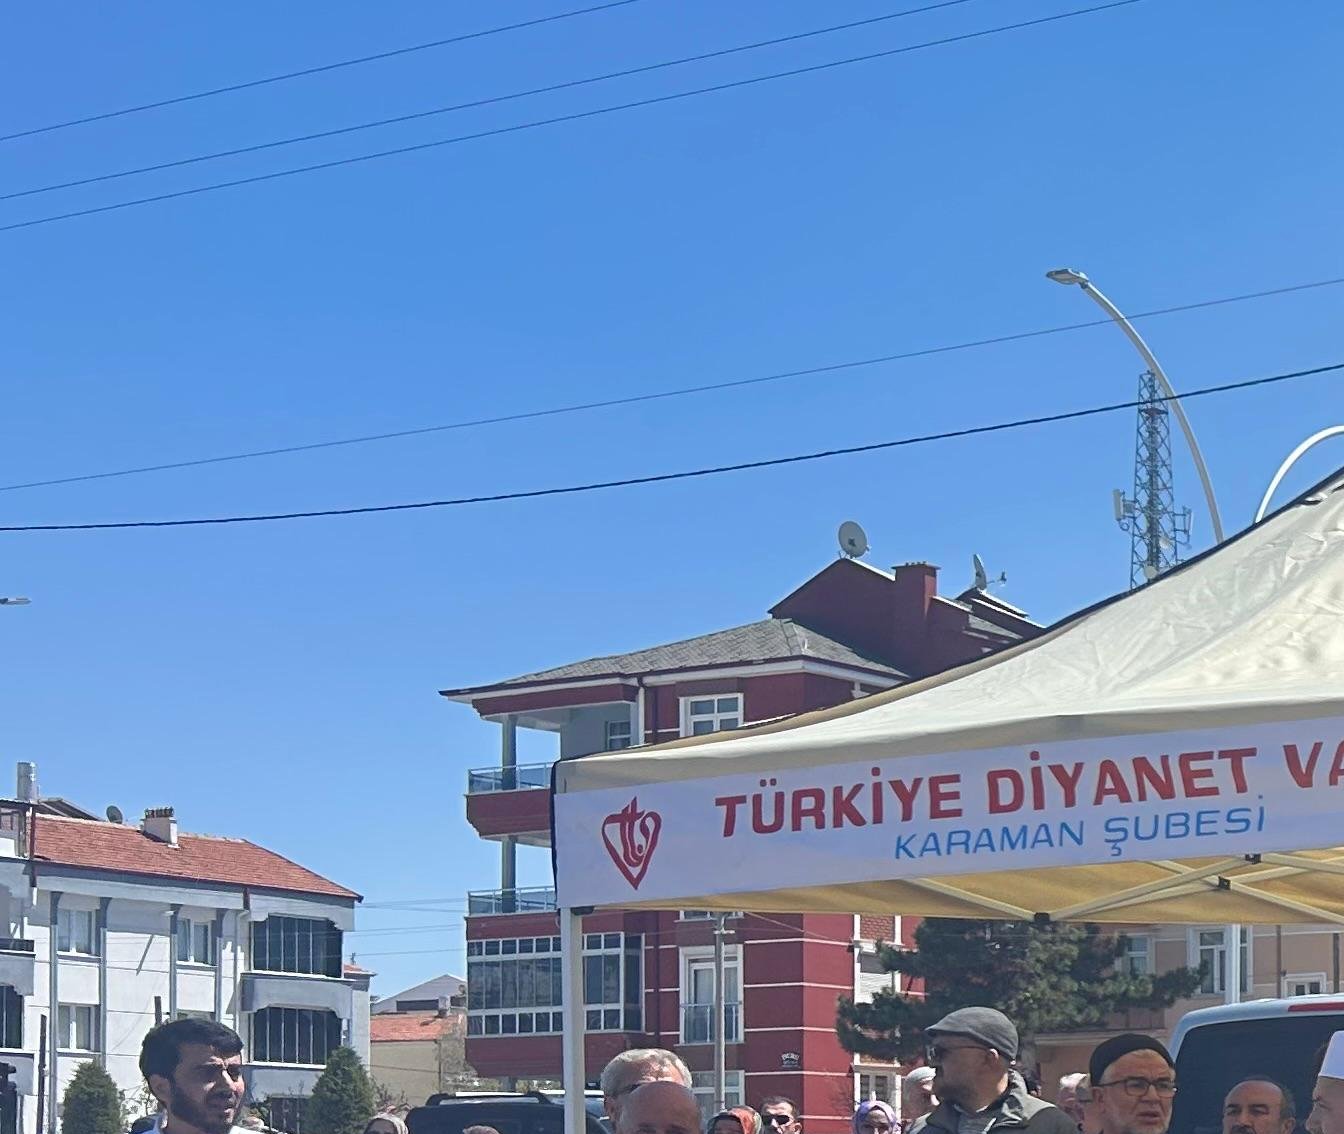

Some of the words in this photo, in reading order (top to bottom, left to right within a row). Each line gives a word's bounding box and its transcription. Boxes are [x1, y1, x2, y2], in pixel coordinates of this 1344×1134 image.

[715, 765, 963, 838] TÜRKİYE
[987, 746, 1258, 816] DİYANET
[895, 820, 1084, 859] KARAMAN
[1104, 794, 1265, 857] ŞUBESİ
